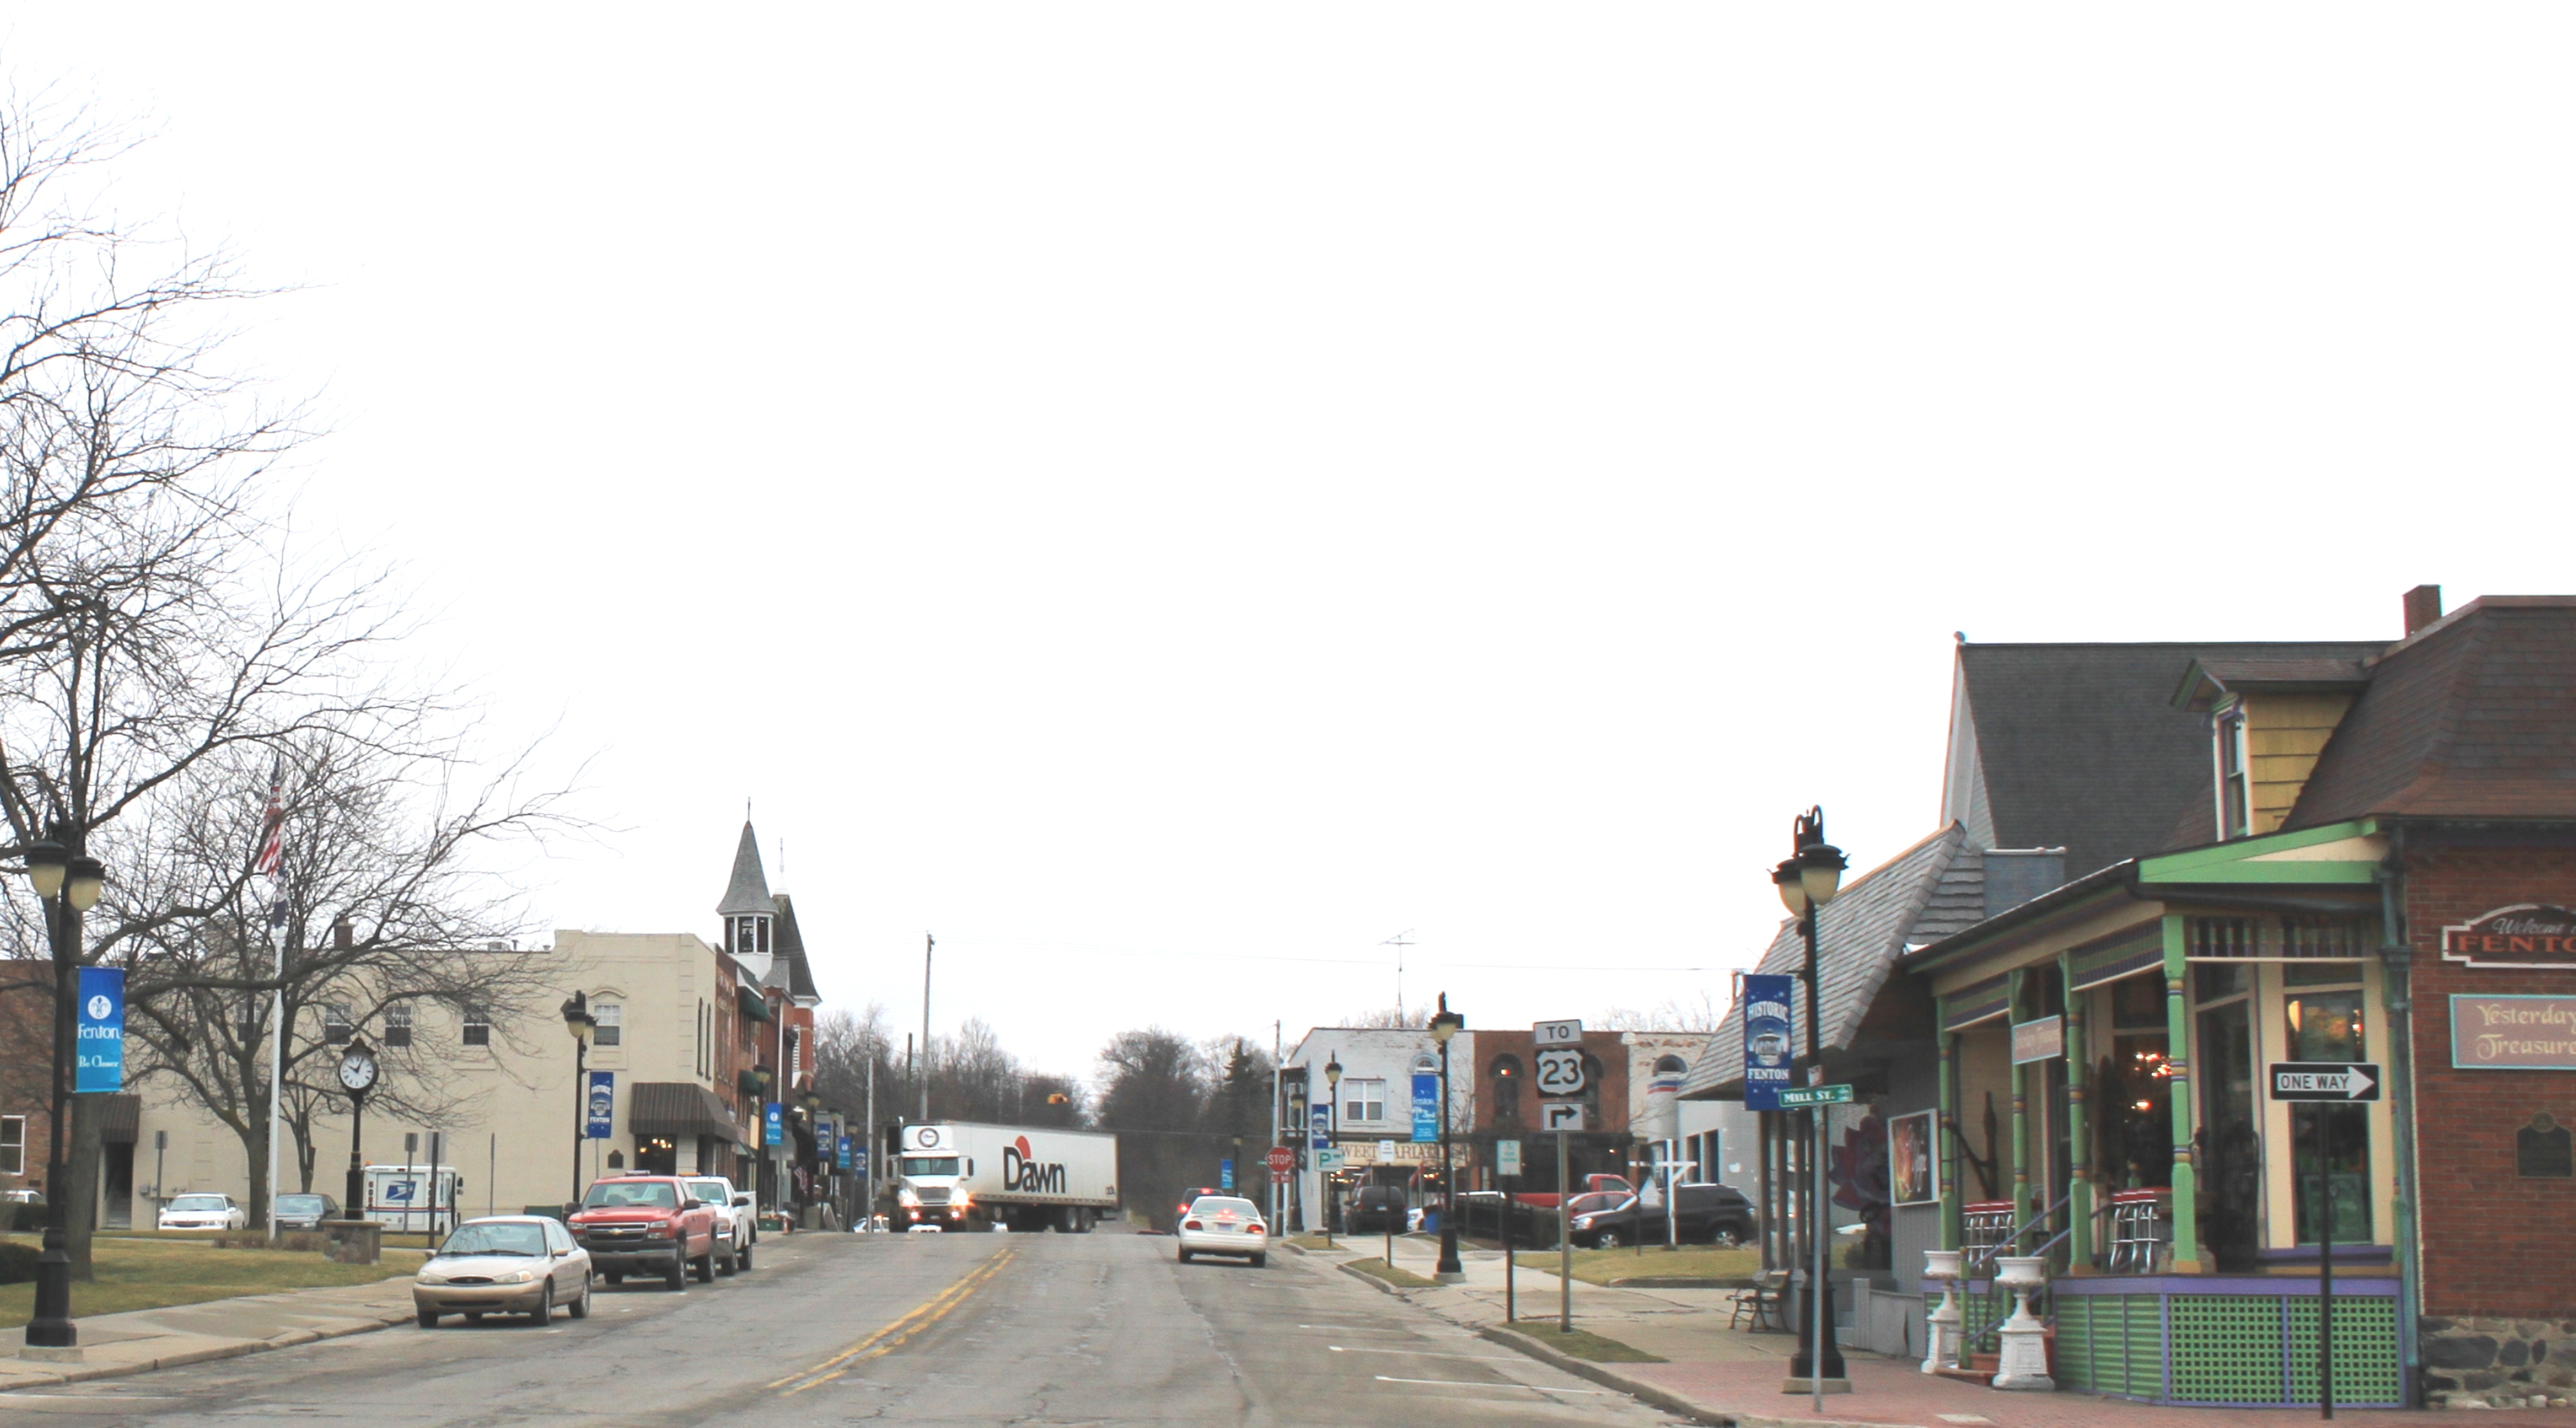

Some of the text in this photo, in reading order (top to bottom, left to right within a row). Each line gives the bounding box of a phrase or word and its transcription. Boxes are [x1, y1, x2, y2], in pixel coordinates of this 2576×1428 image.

[2492, 917, 2565, 935] Welcome
[1747, 1001, 1788, 1024] HISTORIC
[78, 1023, 120, 1039] Fenton
[1546, 1025, 1569, 1039] TO
[1542, 1058, 1580, 1085] 23
[1747, 1068, 1789, 1080] FENTON
[2281, 1075, 2349, 1089] ONE WAY
[1783, 1092, 1813, 1103] MILL
[1340, 1144, 1379, 1158] WEET
[1268, 1154, 1291, 1165] STOP
[1319, 1153, 1331, 1167] P
[1003, 1146, 1066, 1194] Dawn
